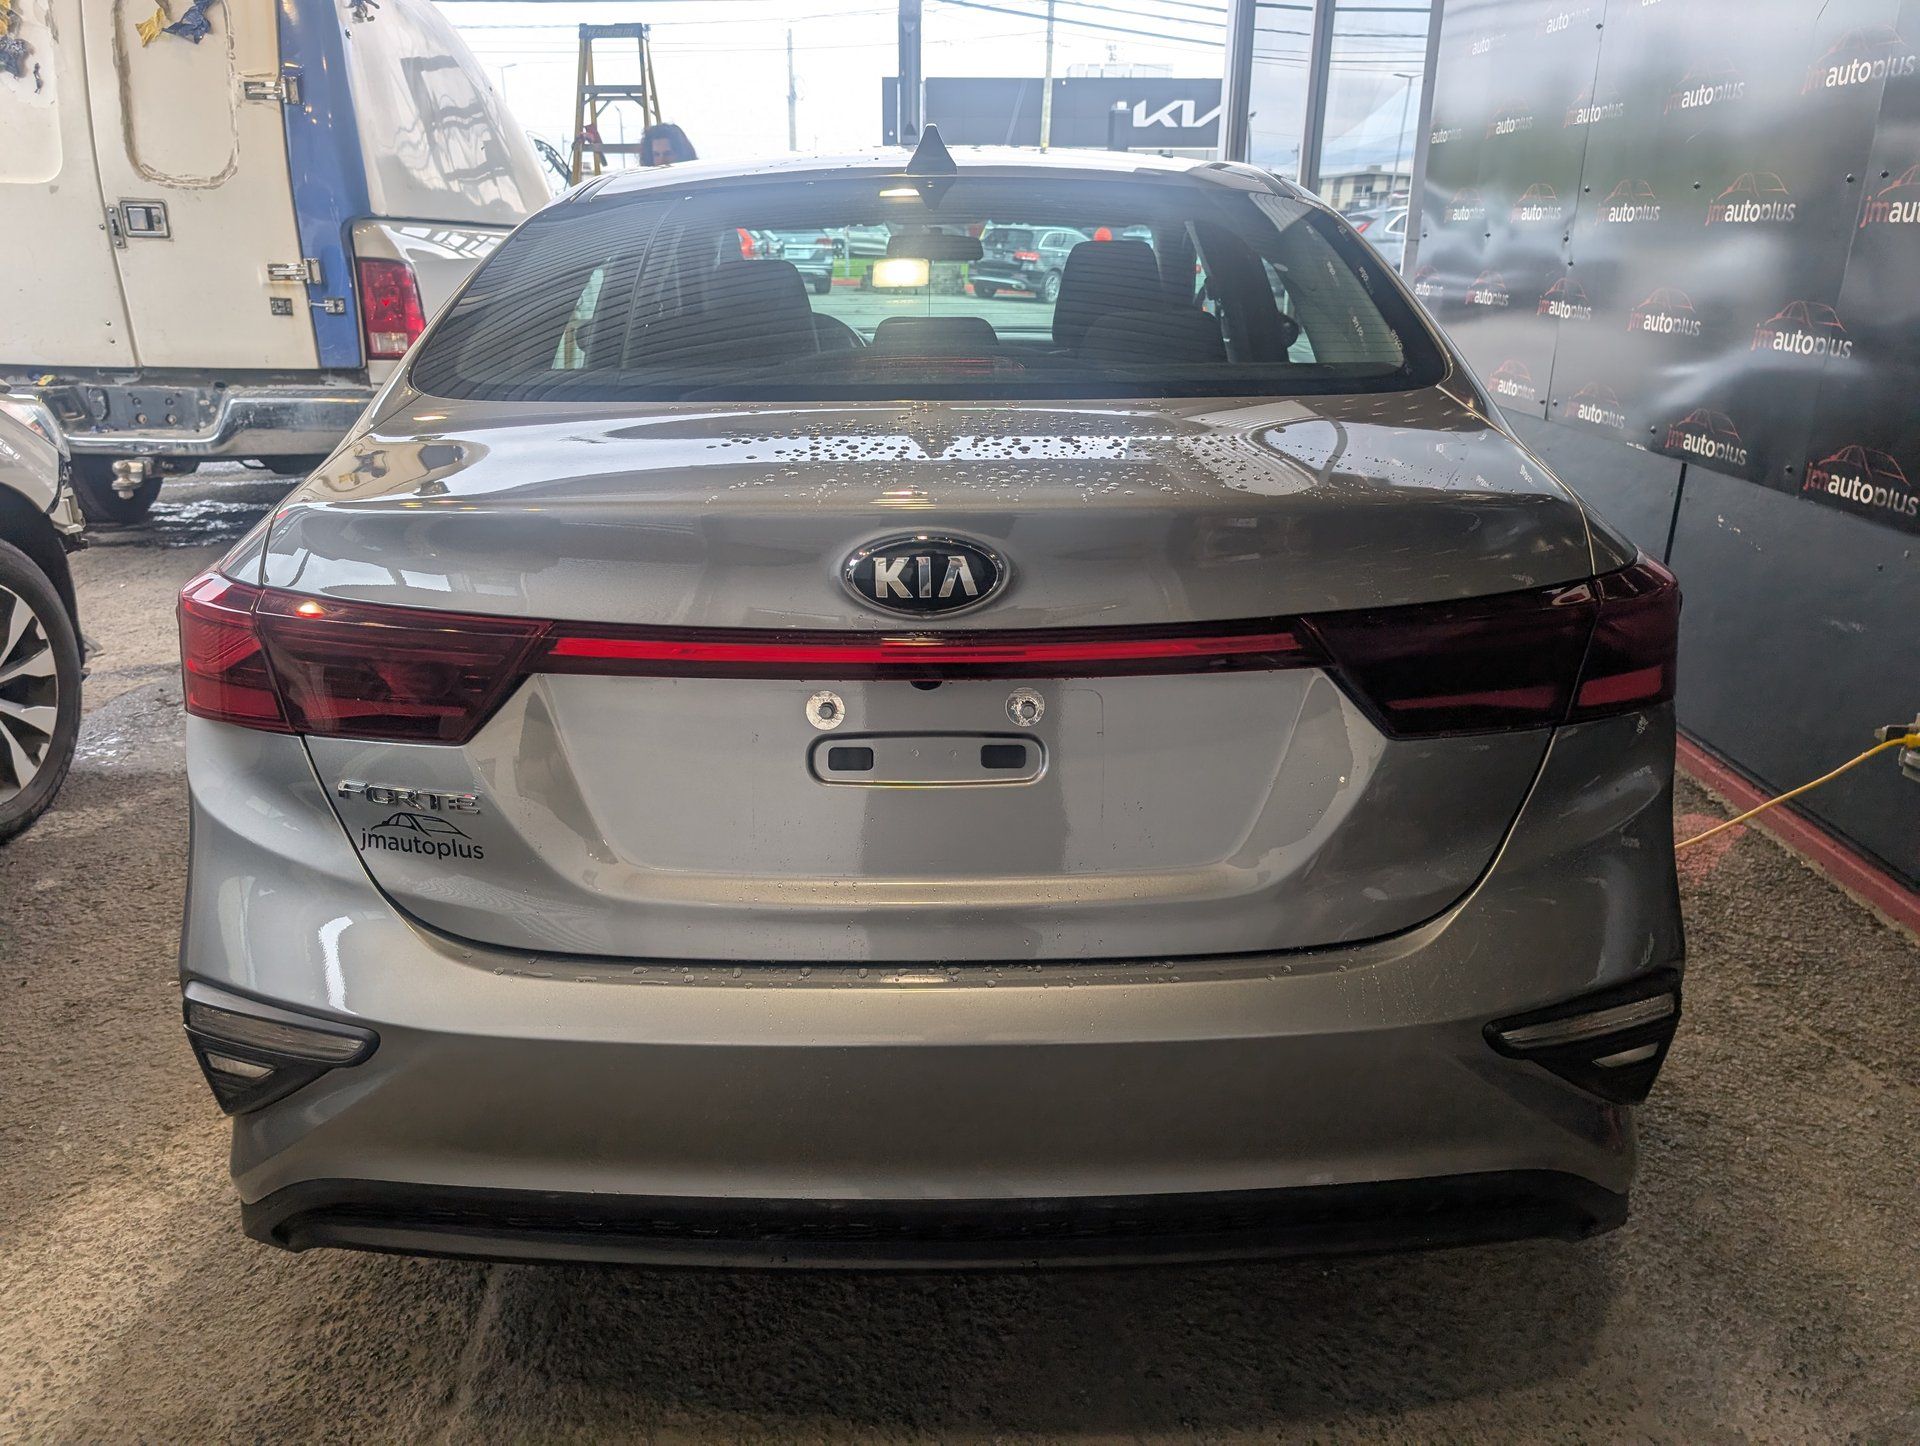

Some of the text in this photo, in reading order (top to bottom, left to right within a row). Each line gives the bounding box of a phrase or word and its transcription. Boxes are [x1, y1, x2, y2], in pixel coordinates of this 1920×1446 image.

[1800, 54, 1916, 96] jmautoplus
[1663, 80, 1745, 116] jmautoplus
[1509, 203, 1562, 224] jmautoplus
[1595, 202, 1661, 226] jmautoplus
[1705, 199, 1796, 226] jmautoplus
[1536, 295, 1592, 321] jmautoplus
[1626, 308, 1702, 337] jmautoplus
[1751, 323, 1853, 359] jmautoplus
[1564, 396, 1625, 430] jmautoplus
[1664, 424, 1748, 467] jmautoplus
[1803, 462, 1920, 516] jmautoplus
[872, 555, 979, 599] KIA
[337, 779, 479, 815] FORTE
[360, 827, 484, 860] jmautoplus
